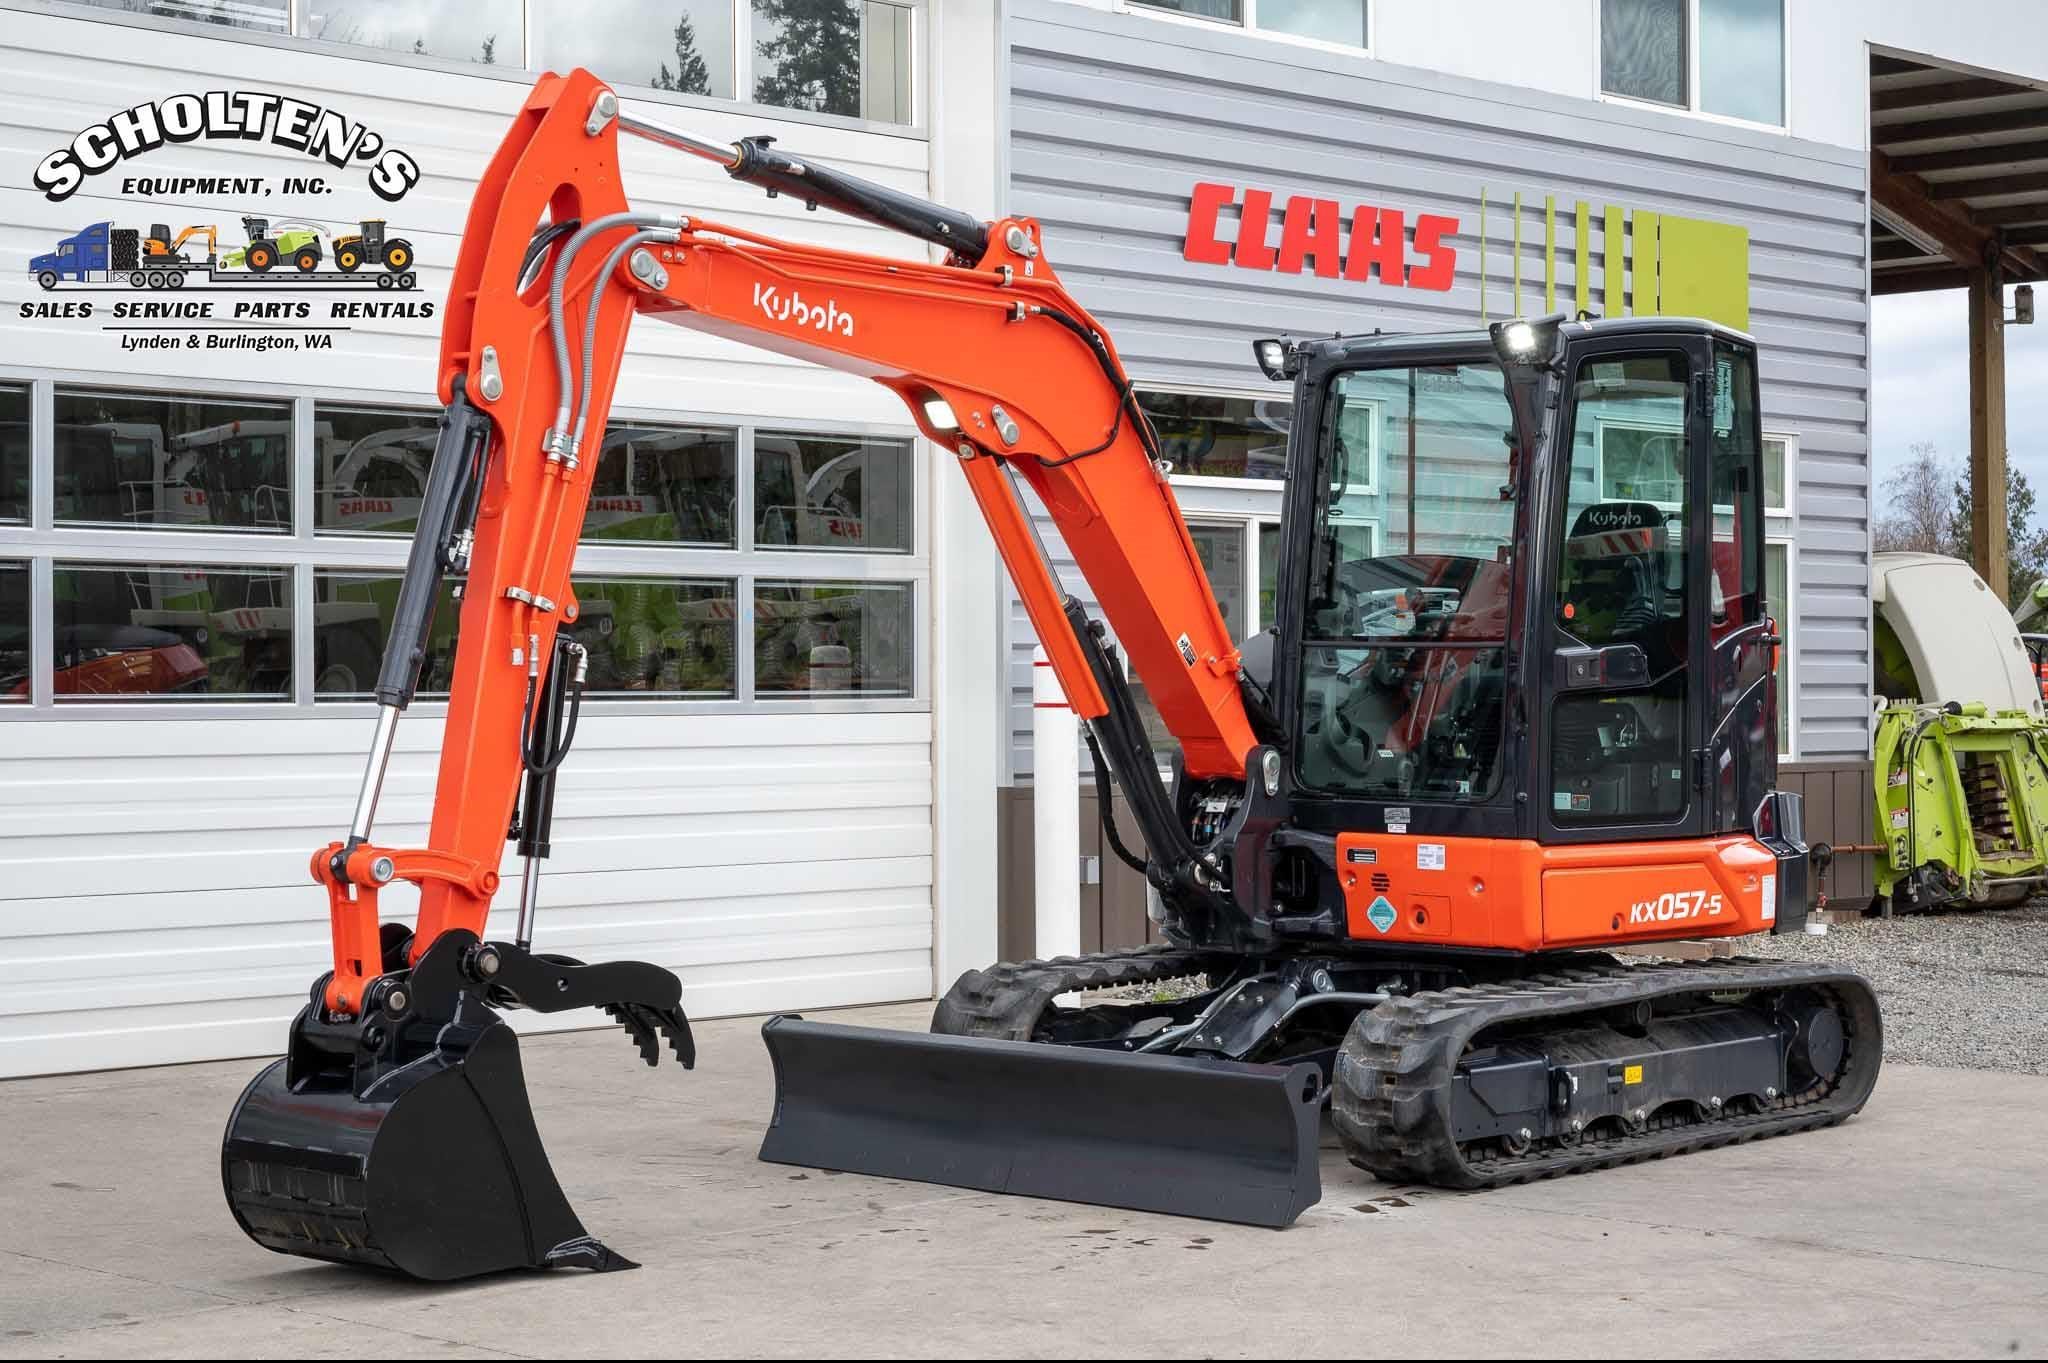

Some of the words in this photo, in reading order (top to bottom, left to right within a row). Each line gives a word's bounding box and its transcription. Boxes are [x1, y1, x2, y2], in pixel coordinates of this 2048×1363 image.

[1183, 182, 1460, 292] CLAAS
[753, 282, 854, 337] Kubota
[1589, 511, 1642, 526] Kubota
[1629, 890, 1723, 924] KX057-5
